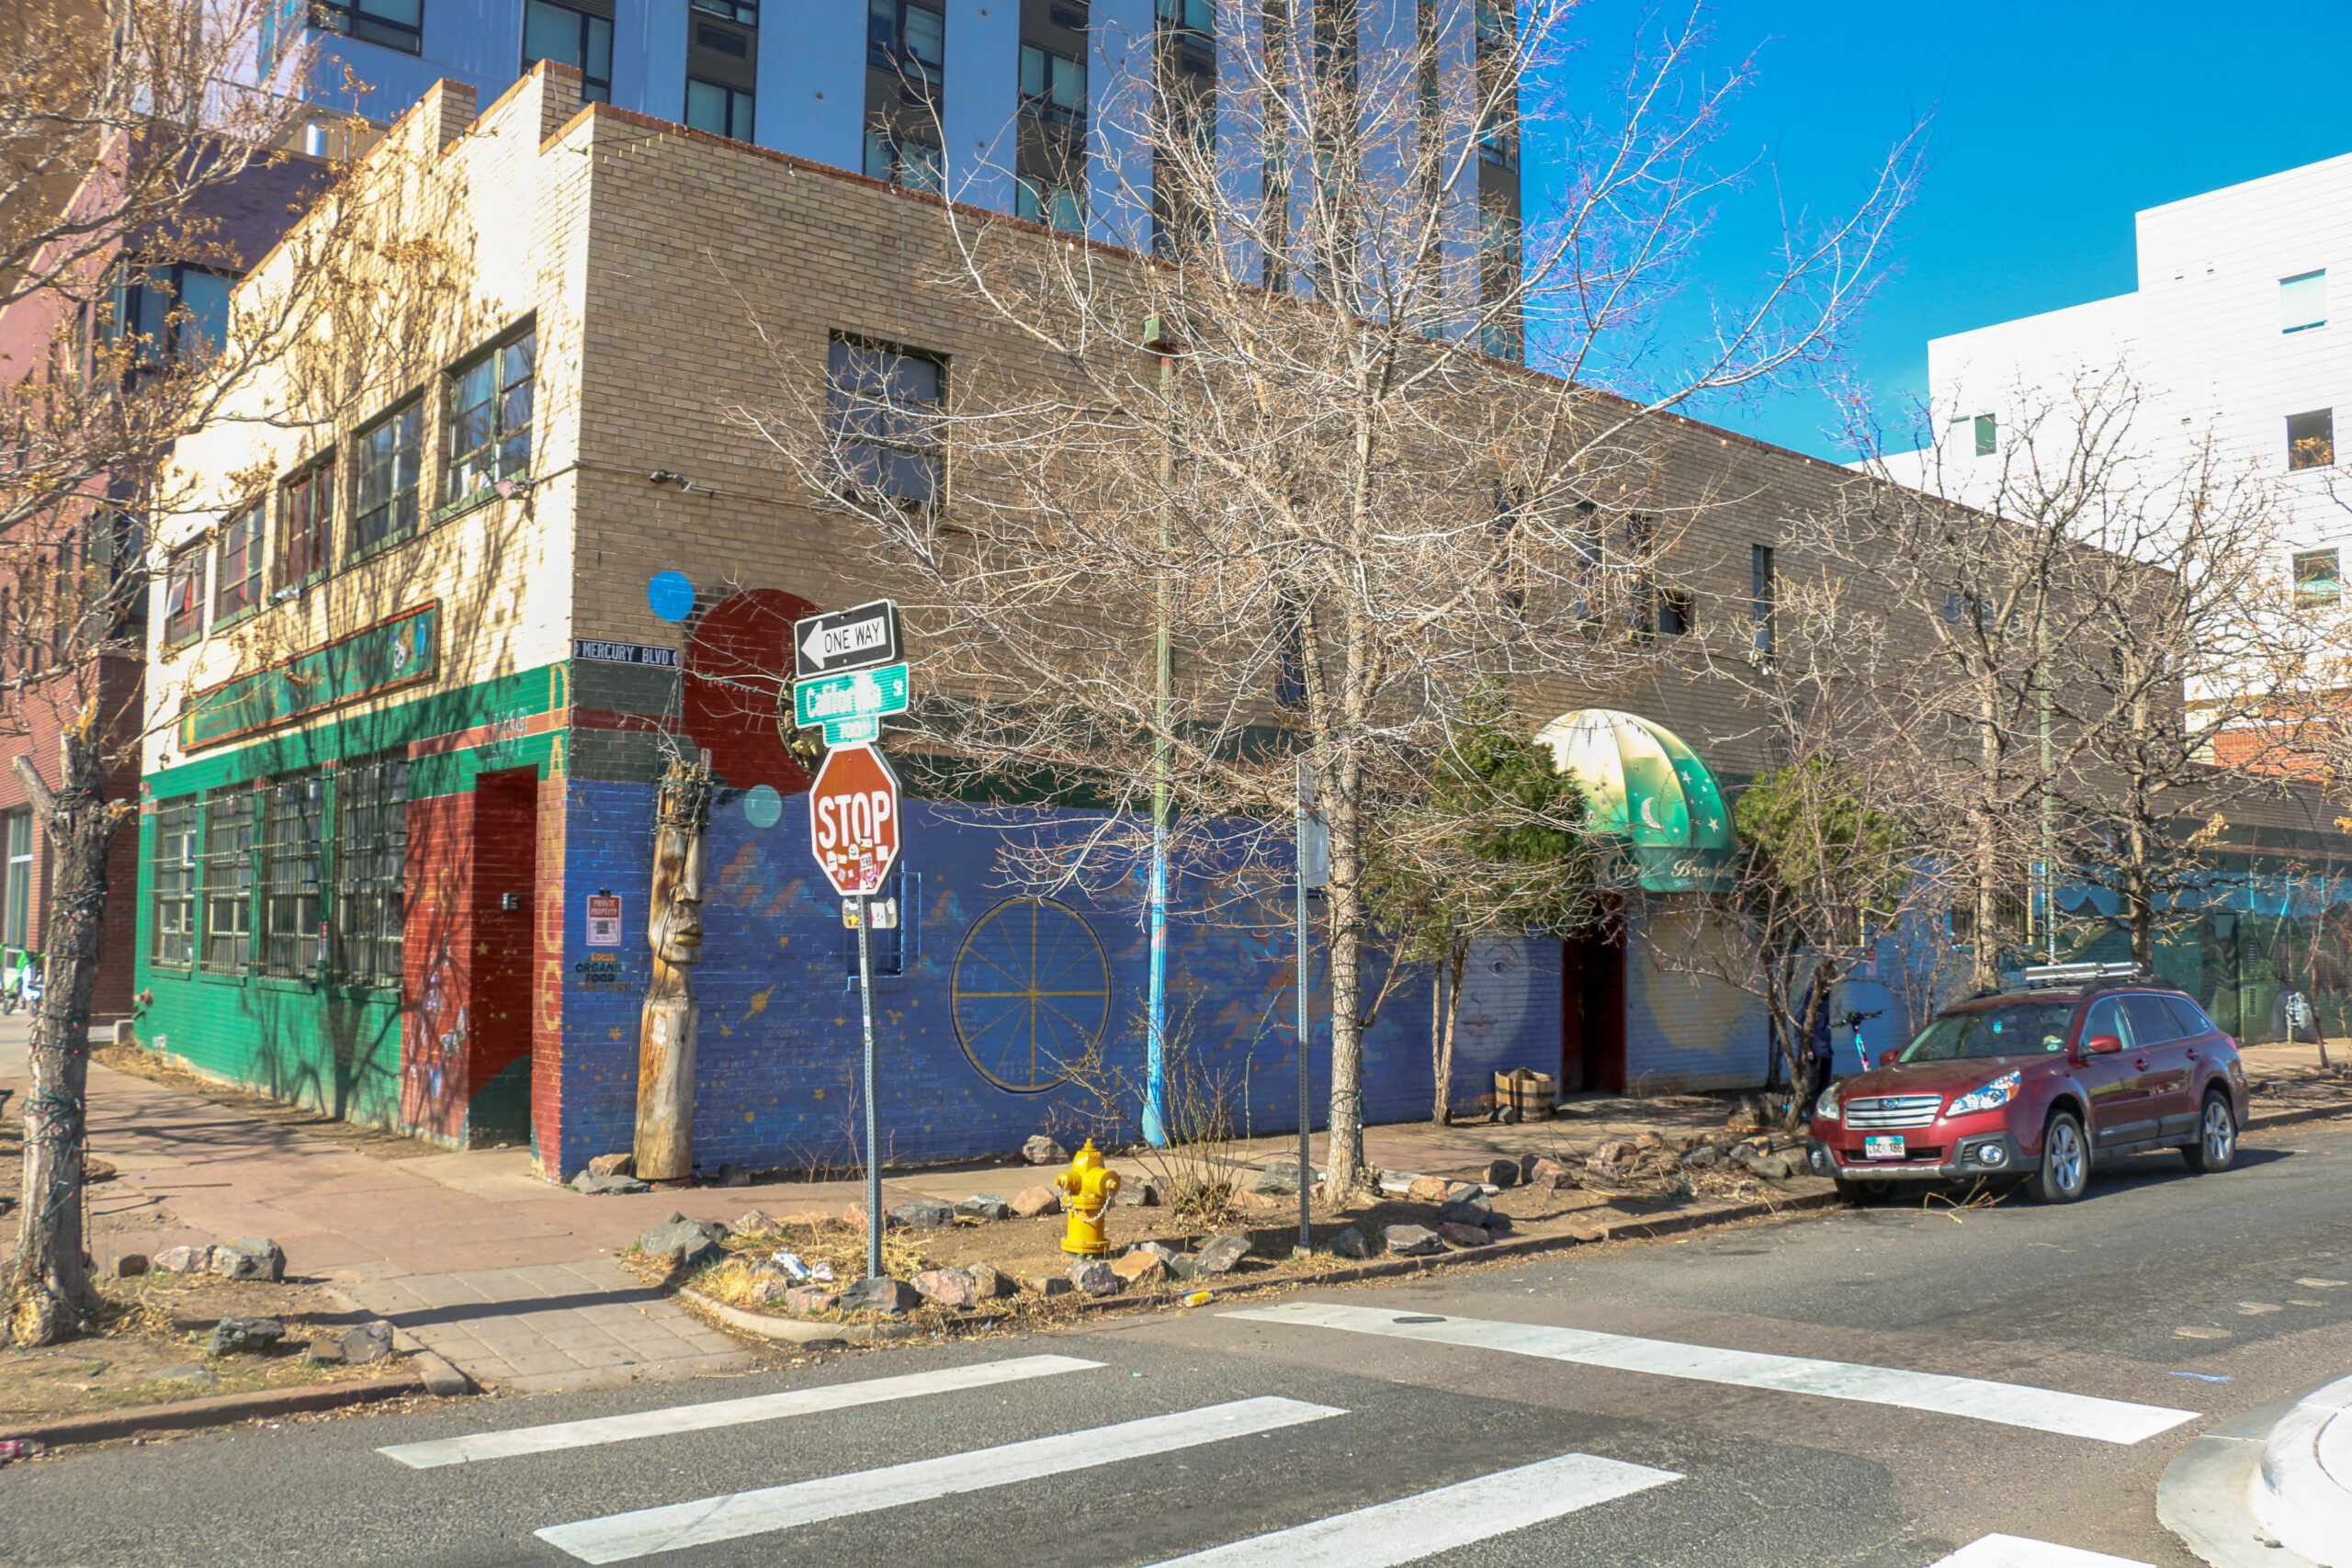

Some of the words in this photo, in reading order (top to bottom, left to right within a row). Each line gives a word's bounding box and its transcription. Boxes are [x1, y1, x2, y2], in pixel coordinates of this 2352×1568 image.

[824, 628, 851, 653] ONE
[855, 621, 880, 647] WAY
[582, 641, 635, 661] MERCURY
[641, 649, 670, 665] BLVD
[806, 680, 882, 718] Californa
[818, 790, 891, 850] STOP
[591, 908, 617, 916] PROPERTY
[594, 899, 616, 908] PRIVATE
[575, 963, 624, 973] ORGANIC
[585, 973, 616, 983] FOOD
